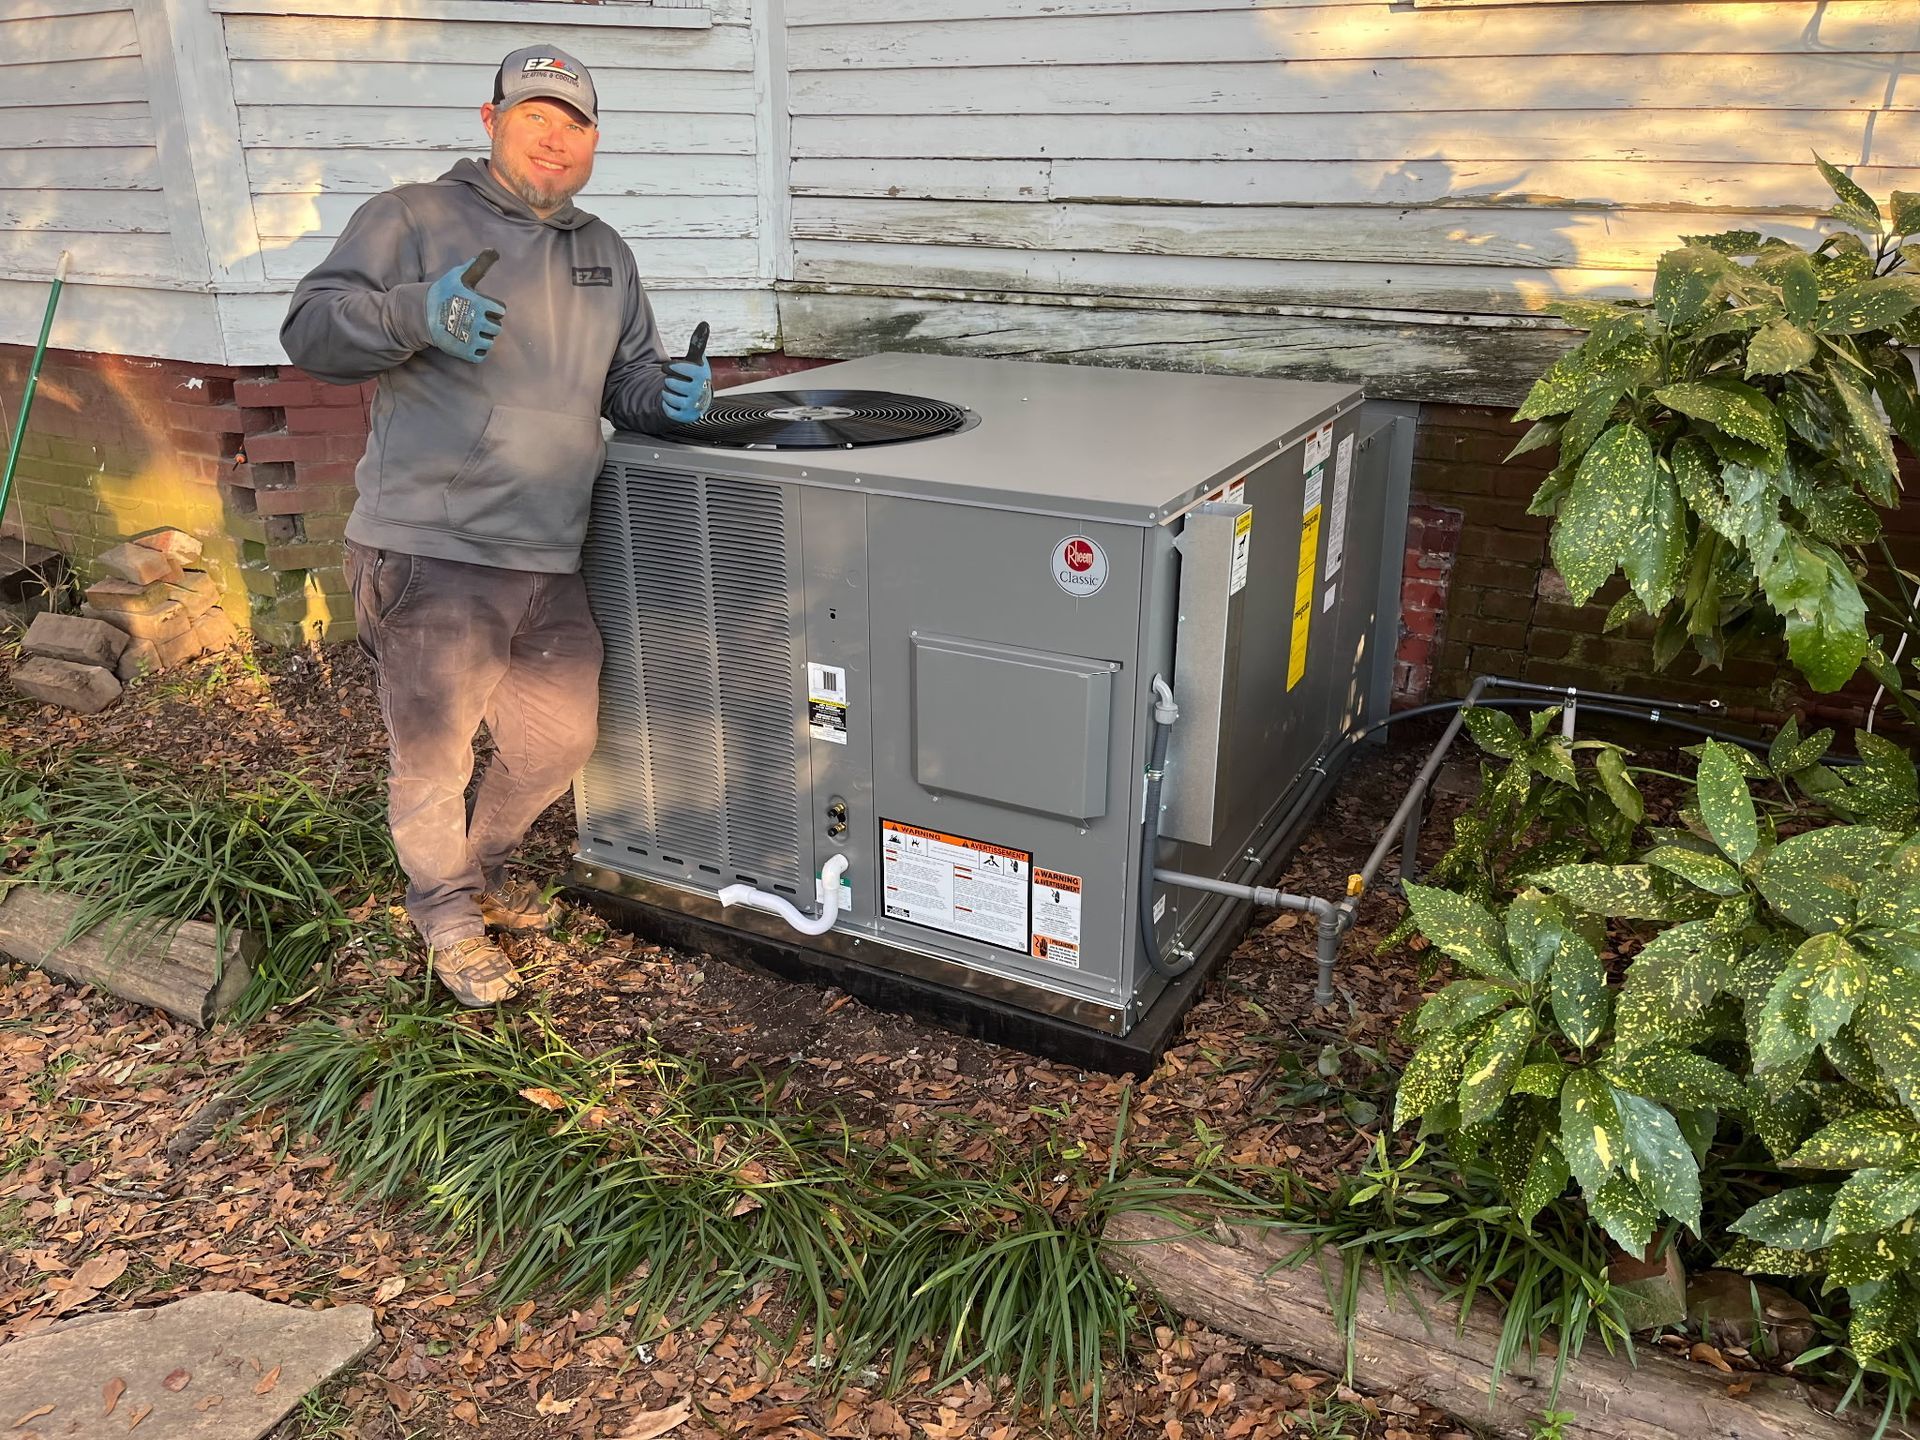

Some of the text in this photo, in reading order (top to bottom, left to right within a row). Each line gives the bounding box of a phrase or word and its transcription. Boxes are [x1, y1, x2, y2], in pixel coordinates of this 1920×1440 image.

[522, 71, 547, 79] HEATING
[555, 74, 579, 87] COOLING
[1068, 541, 1093, 566] Rheem
[1060, 571, 1098, 585] Classic
[900, 826, 941, 841] WARNING
[970, 842, 1025, 860] AVERTISSEMENT
[1041, 871, 1078, 885] WARNING
[1040, 880, 1080, 894] AVERTISSEMENT
